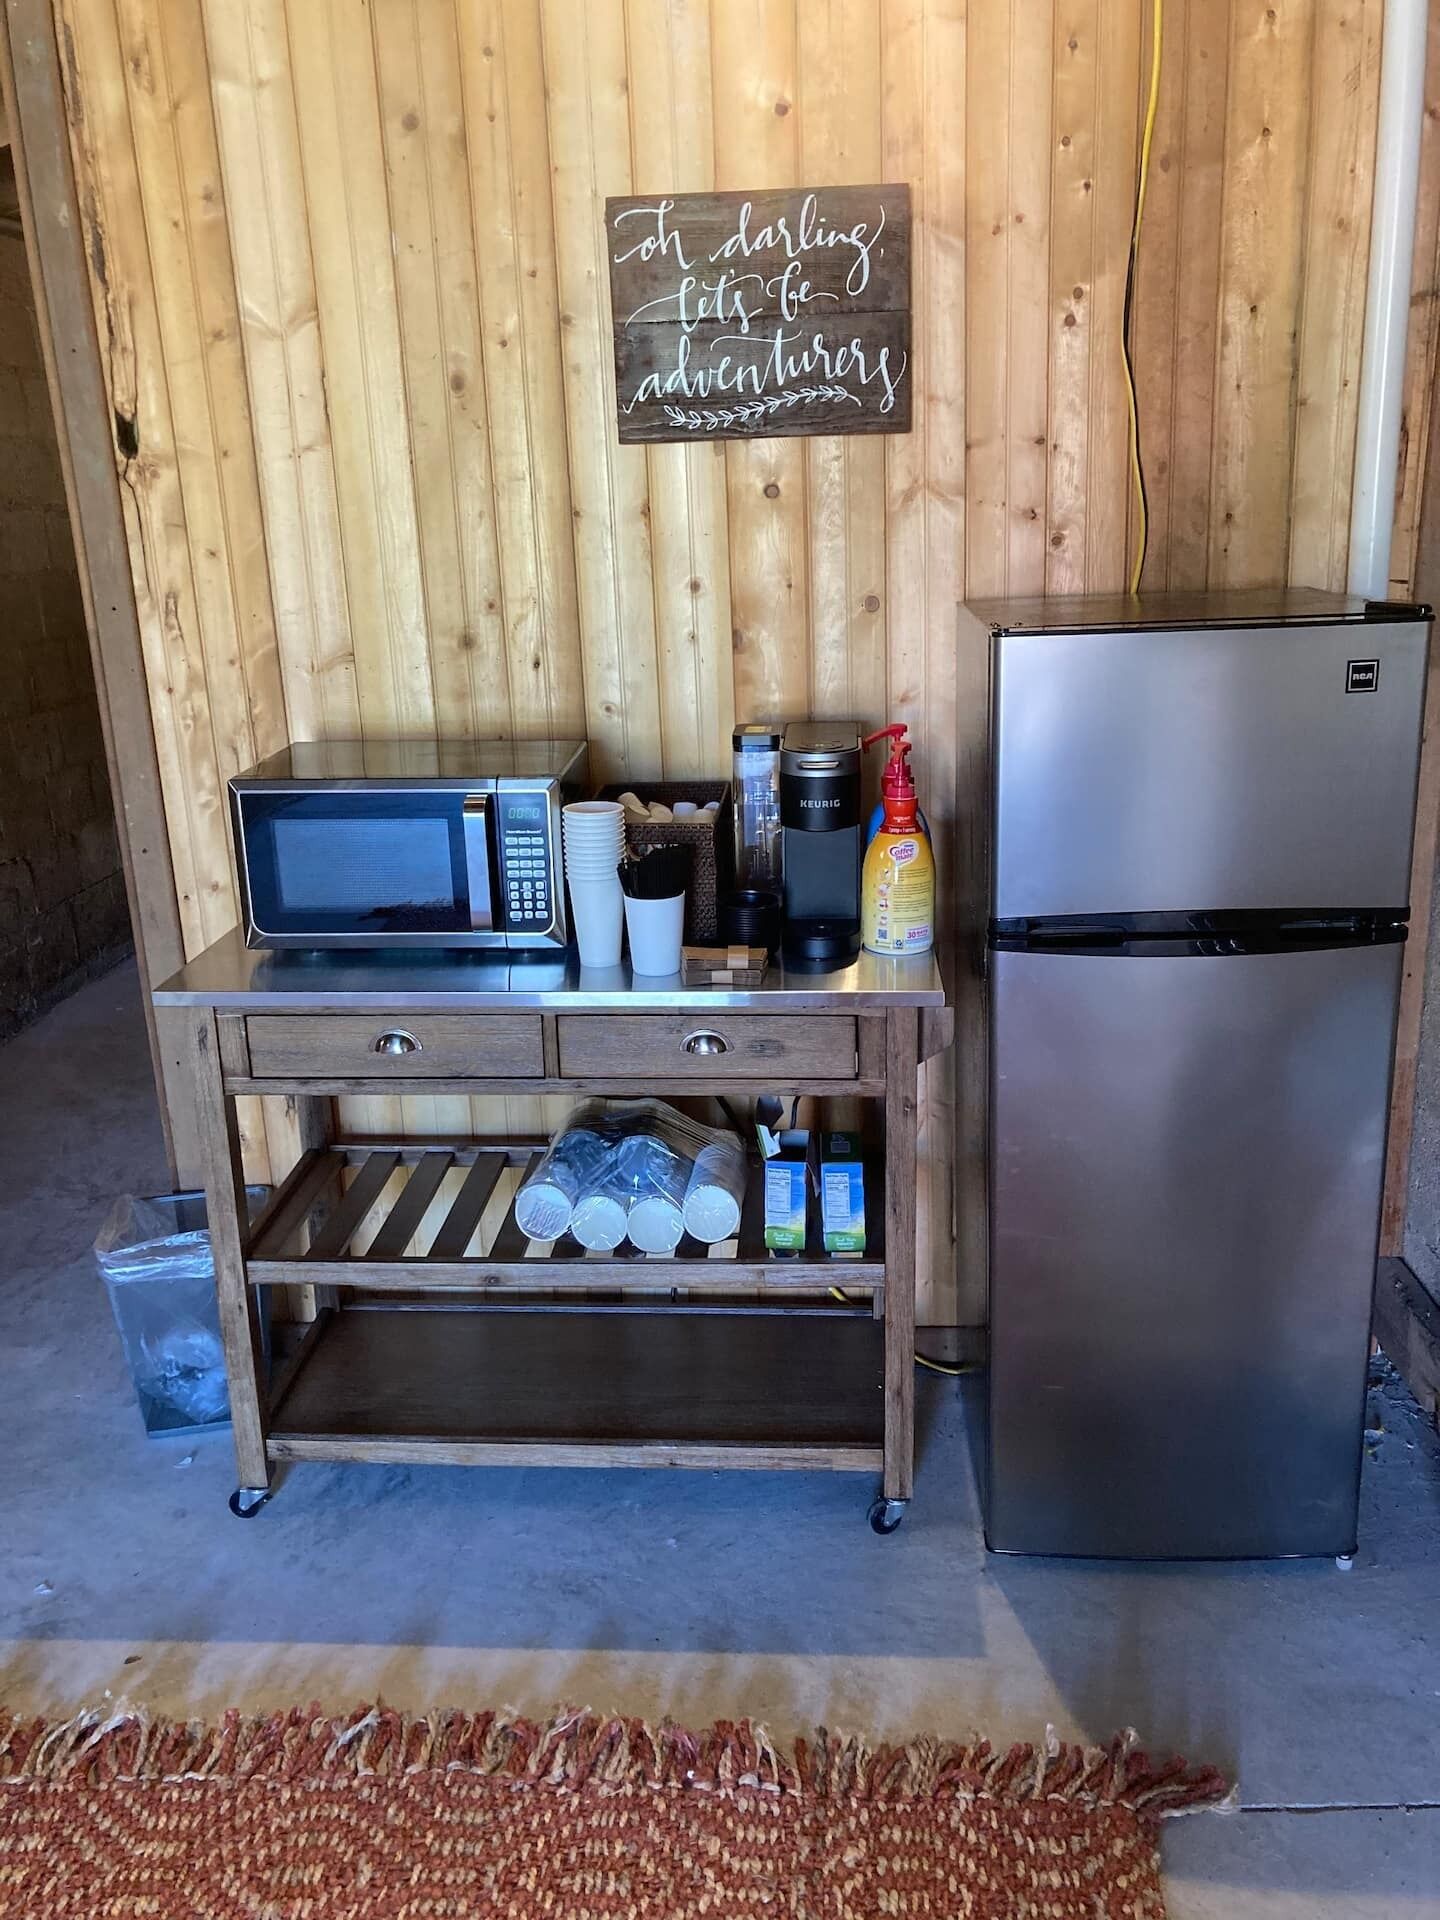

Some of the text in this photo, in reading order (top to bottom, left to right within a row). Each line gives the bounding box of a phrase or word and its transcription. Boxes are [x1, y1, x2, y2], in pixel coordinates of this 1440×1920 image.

[614, 194, 886, 296] oh darling,
[625, 261, 839, 333] let's be
[622, 327, 907, 414] adventurers
[1353, 672, 1373, 680] RCA
[800, 799, 841, 809] KEURIG
[889, 846, 915, 857] Coffee
[906, 930, 916, 939] 30
